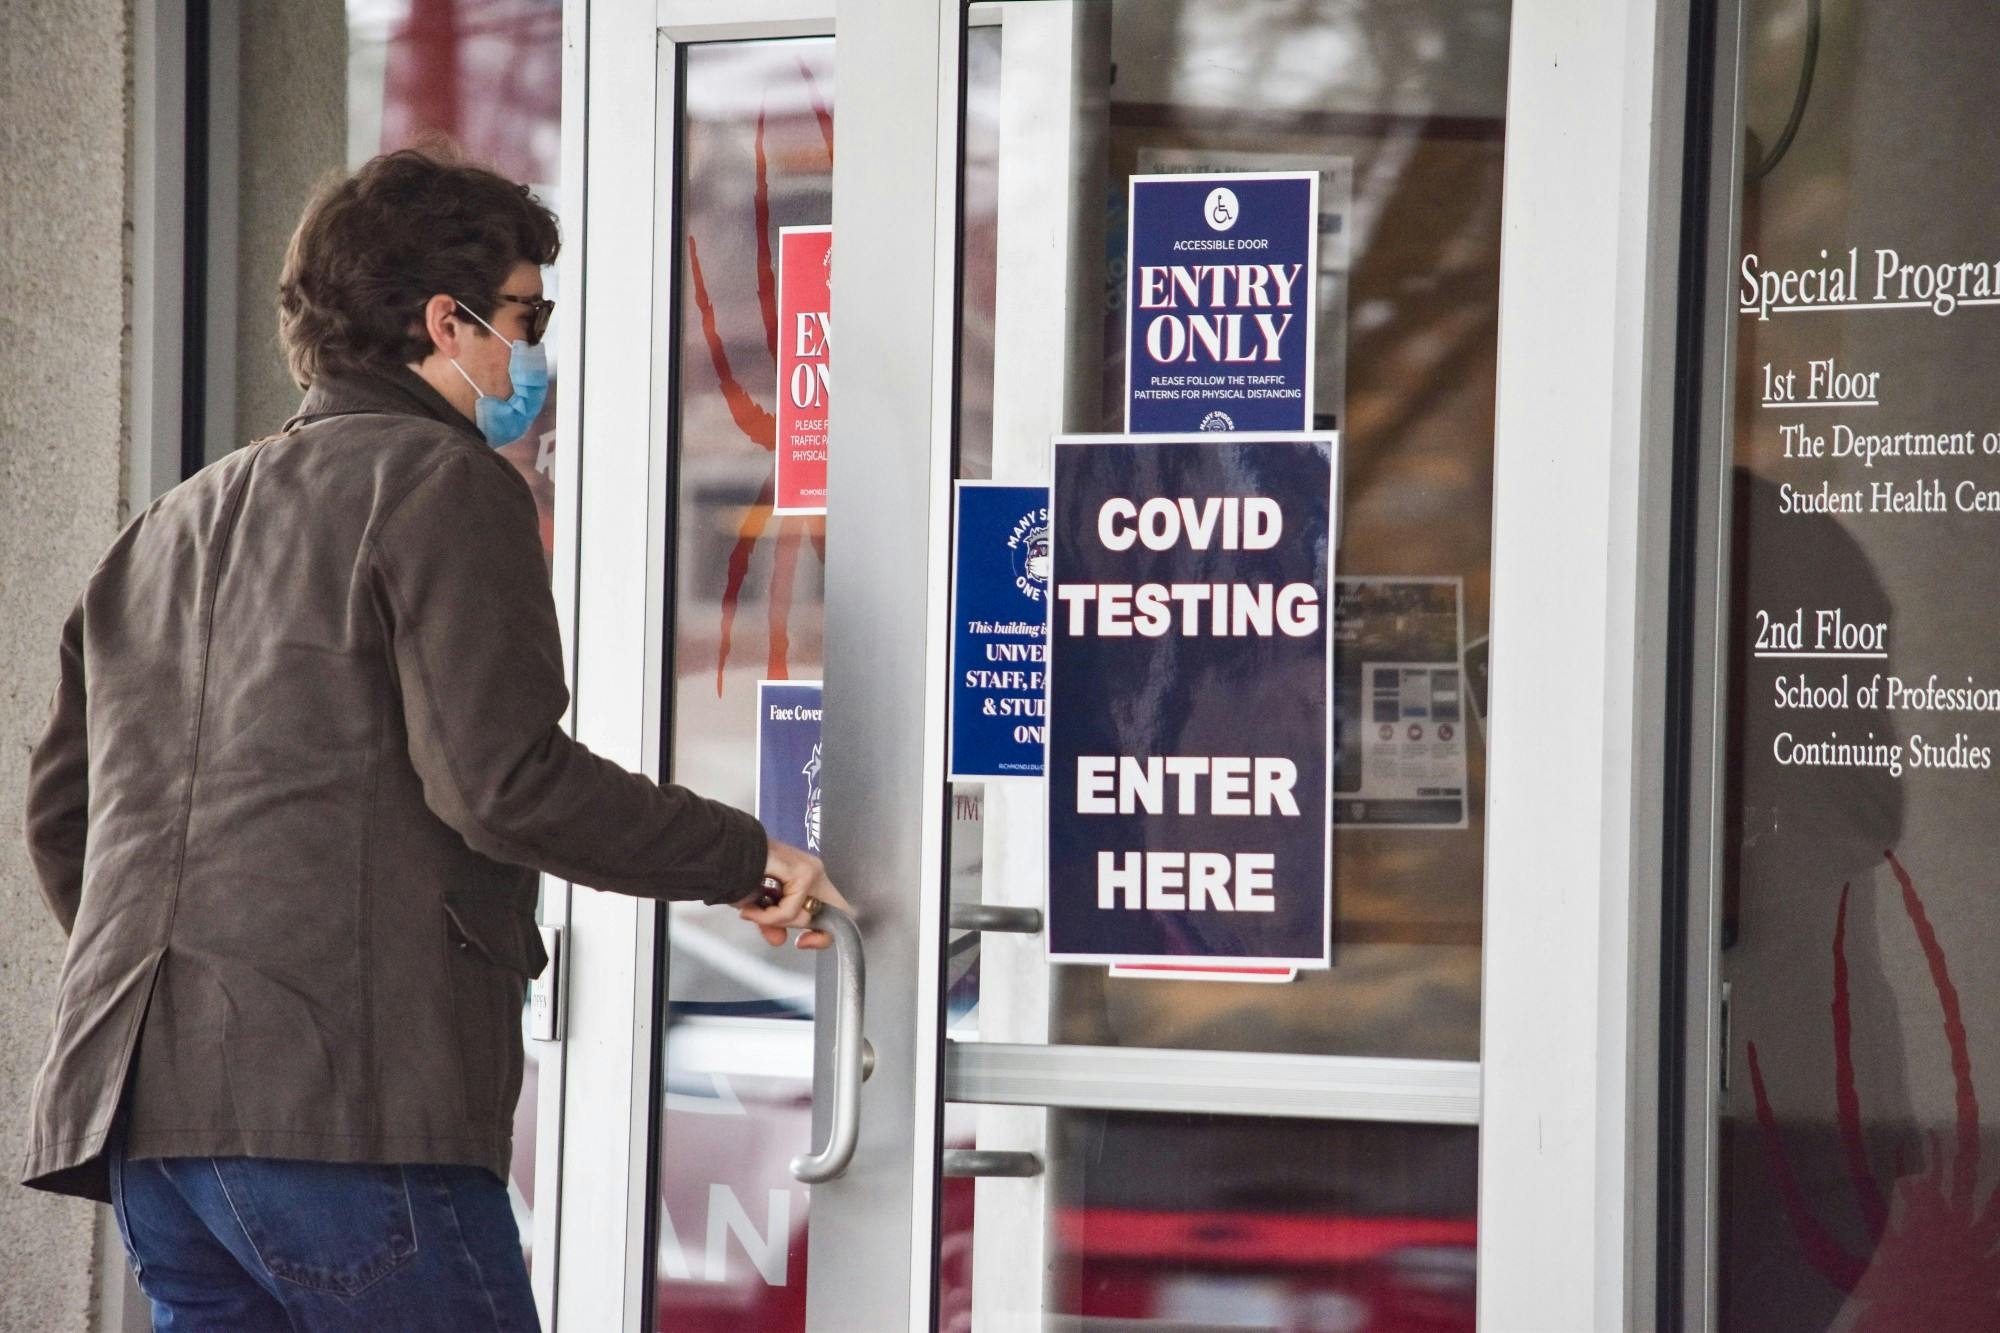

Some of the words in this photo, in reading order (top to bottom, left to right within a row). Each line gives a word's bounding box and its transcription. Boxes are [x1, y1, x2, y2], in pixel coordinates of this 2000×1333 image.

[1173, 239, 1235, 251] ACCESSIBLE
[1237, 239, 1268, 250] DOOR
[1139, 264, 1303, 309] ENTRY
[1740, 247, 1858, 320] Special
[1147, 313, 1294, 364] ONLY
[1134, 389, 1180, 399] PATTERNS
[1181, 389, 1200, 399] FOR
[1202, 389, 1245, 399] PHYSICAL
[1247, 389, 1302, 398] DISTANCING
[1151, 376, 1185, 386] PLEASE
[1187, 376, 1226, 385] FOLLOW
[1228, 375, 1245, 385] THE
[1248, 375, 1286, 385] TRAFFIC
[1762, 362, 1796, 401] 1st
[1806, 358, 1881, 400] Floor
[790, 435, 821, 446] TRAFFIC
[795, 419, 823, 431] PLEASE
[792, 450, 829, 461] PHYSICAL
[1779, 423, 1825, 458] The
[1831, 424, 1975, 468] Department
[1982, 432, 2000, 455] o
[1779, 480, 1863, 514] Student
[1869, 479, 1948, 513] Health
[1007, 510, 1037, 550] MANY
[1097, 497, 1284, 552] COVID
[1016, 576, 1041, 601] ONE
[1058, 582, 1320, 637] TESTING
[968, 621, 993, 634] This
[994, 621, 1040, 638] building
[1754, 607, 1804, 649] 2nd
[1814, 607, 1888, 650] Floor
[966, 670, 1028, 691] STAFF,
[1774, 674, 1849, 709] School
[1857, 674, 1881, 709] of
[1886, 674, 2000, 711] Profession
[770, 704, 794, 720] Face
[982, 697, 997, 716] &
[1773, 731, 1903, 778] Continuing
[1909, 733, 1991, 770] Studies
[1077, 755, 1301, 816] ENTER
[1098, 851, 1276, 912] HERE
